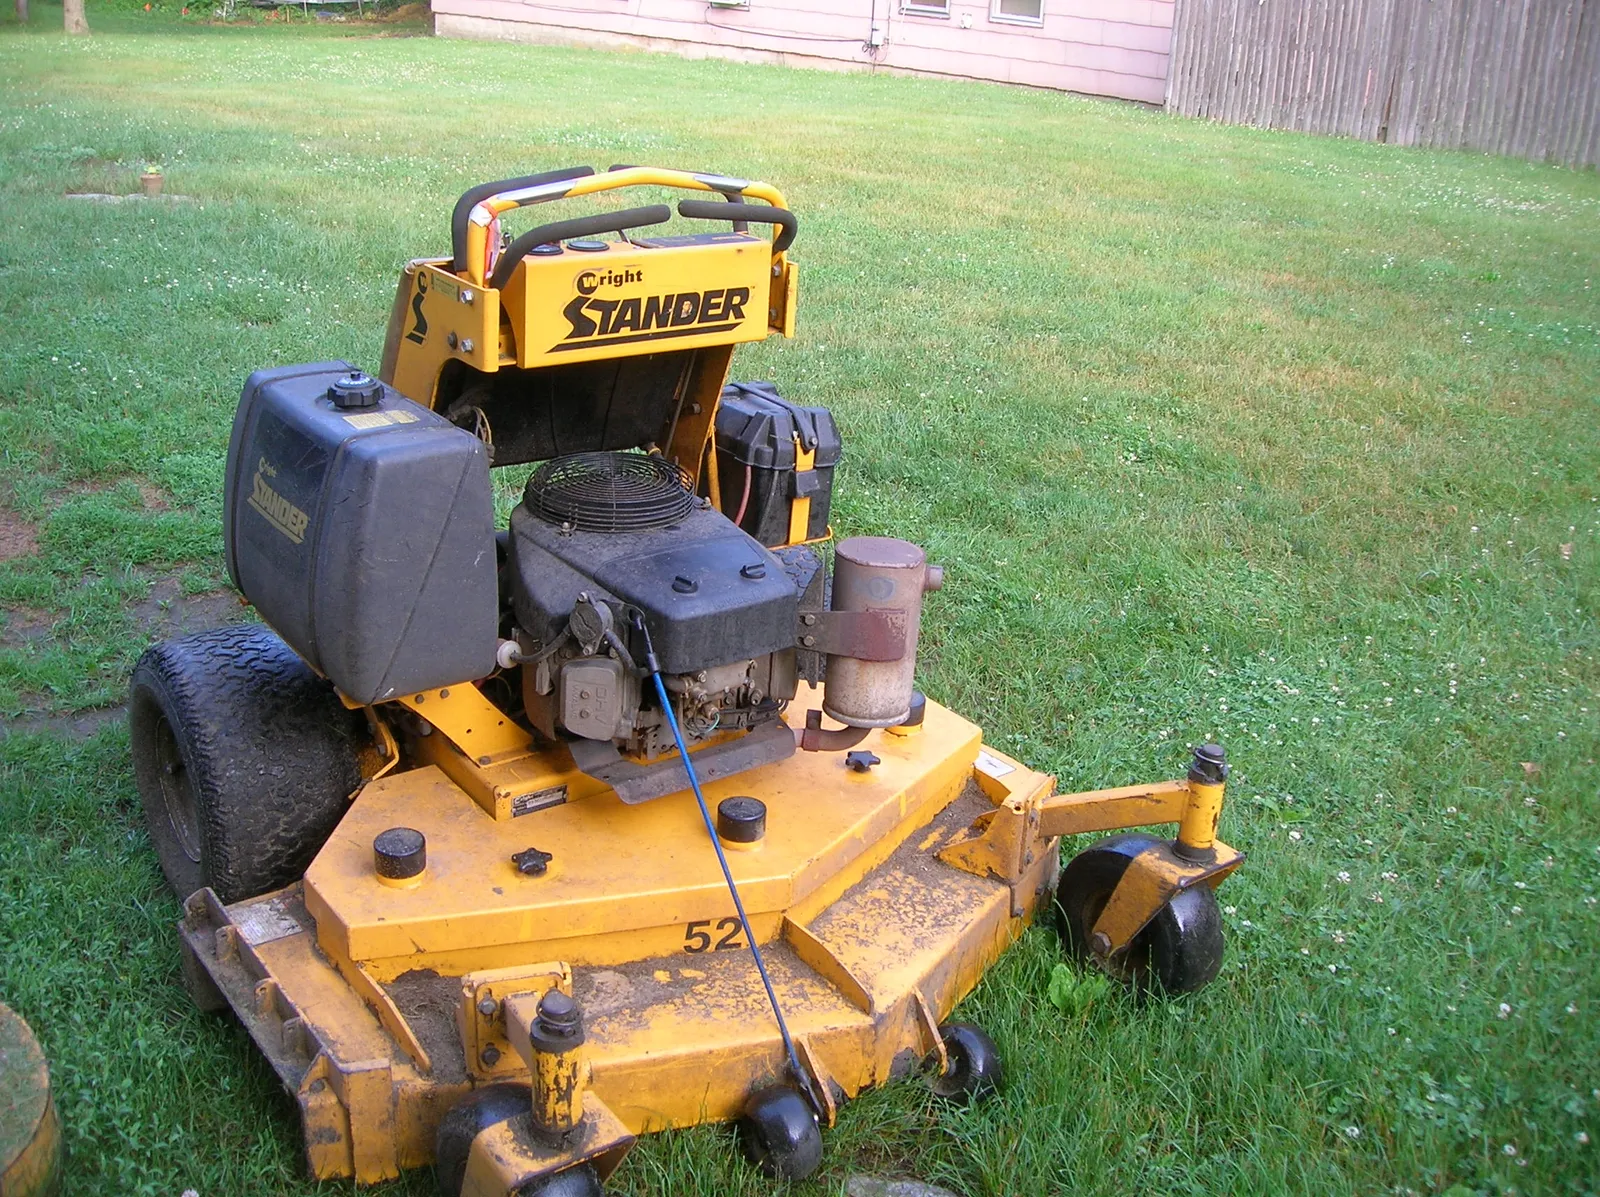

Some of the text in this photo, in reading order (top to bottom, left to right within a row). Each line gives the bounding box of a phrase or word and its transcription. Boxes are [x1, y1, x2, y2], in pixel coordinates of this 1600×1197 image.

[576, 270, 643, 295] Wright
[563, 286, 750, 340] STANDER
[252, 471, 309, 540] STANDER
[683, 916, 742, 953] 52
